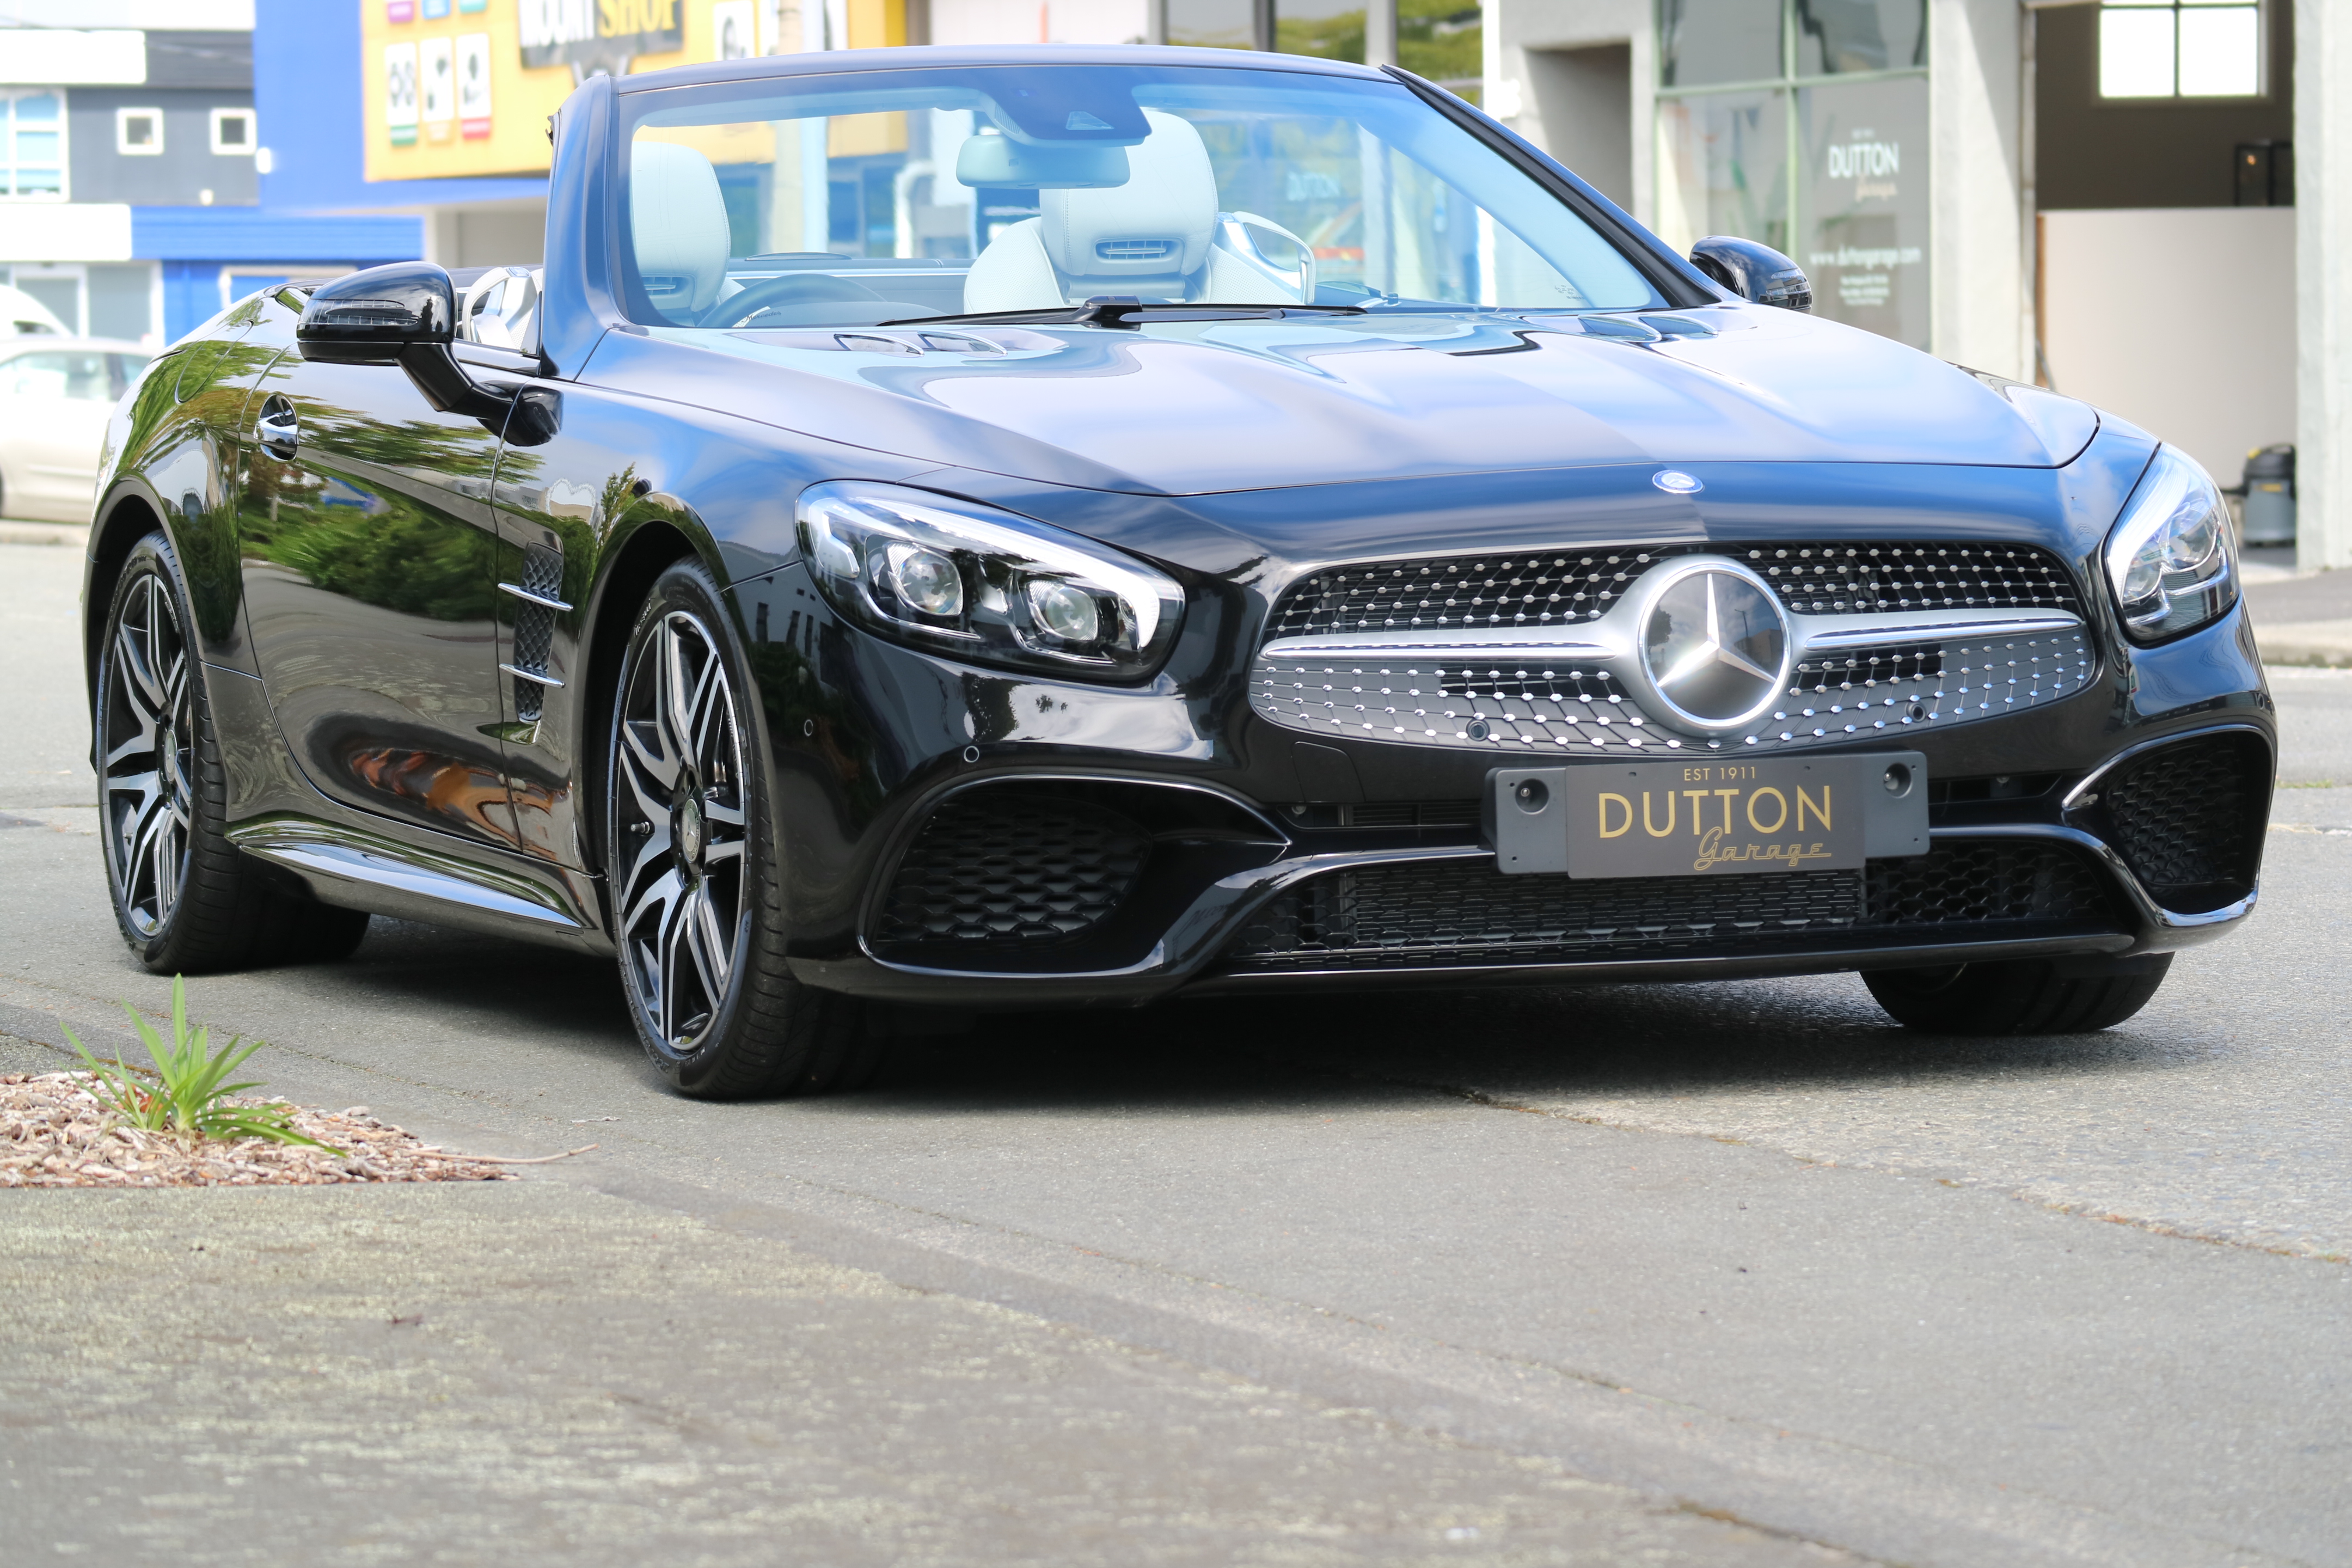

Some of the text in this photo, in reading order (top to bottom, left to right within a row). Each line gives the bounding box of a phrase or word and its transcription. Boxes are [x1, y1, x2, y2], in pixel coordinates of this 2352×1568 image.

[1828, 142, 1899, 179] DUTTON
[742, 311, 782, 323] Mercedes
[1684, 767, 1756, 781] EST 1911
[1598, 785, 1831, 838] DUTTON
[1693, 826, 1832, 871] Garage
